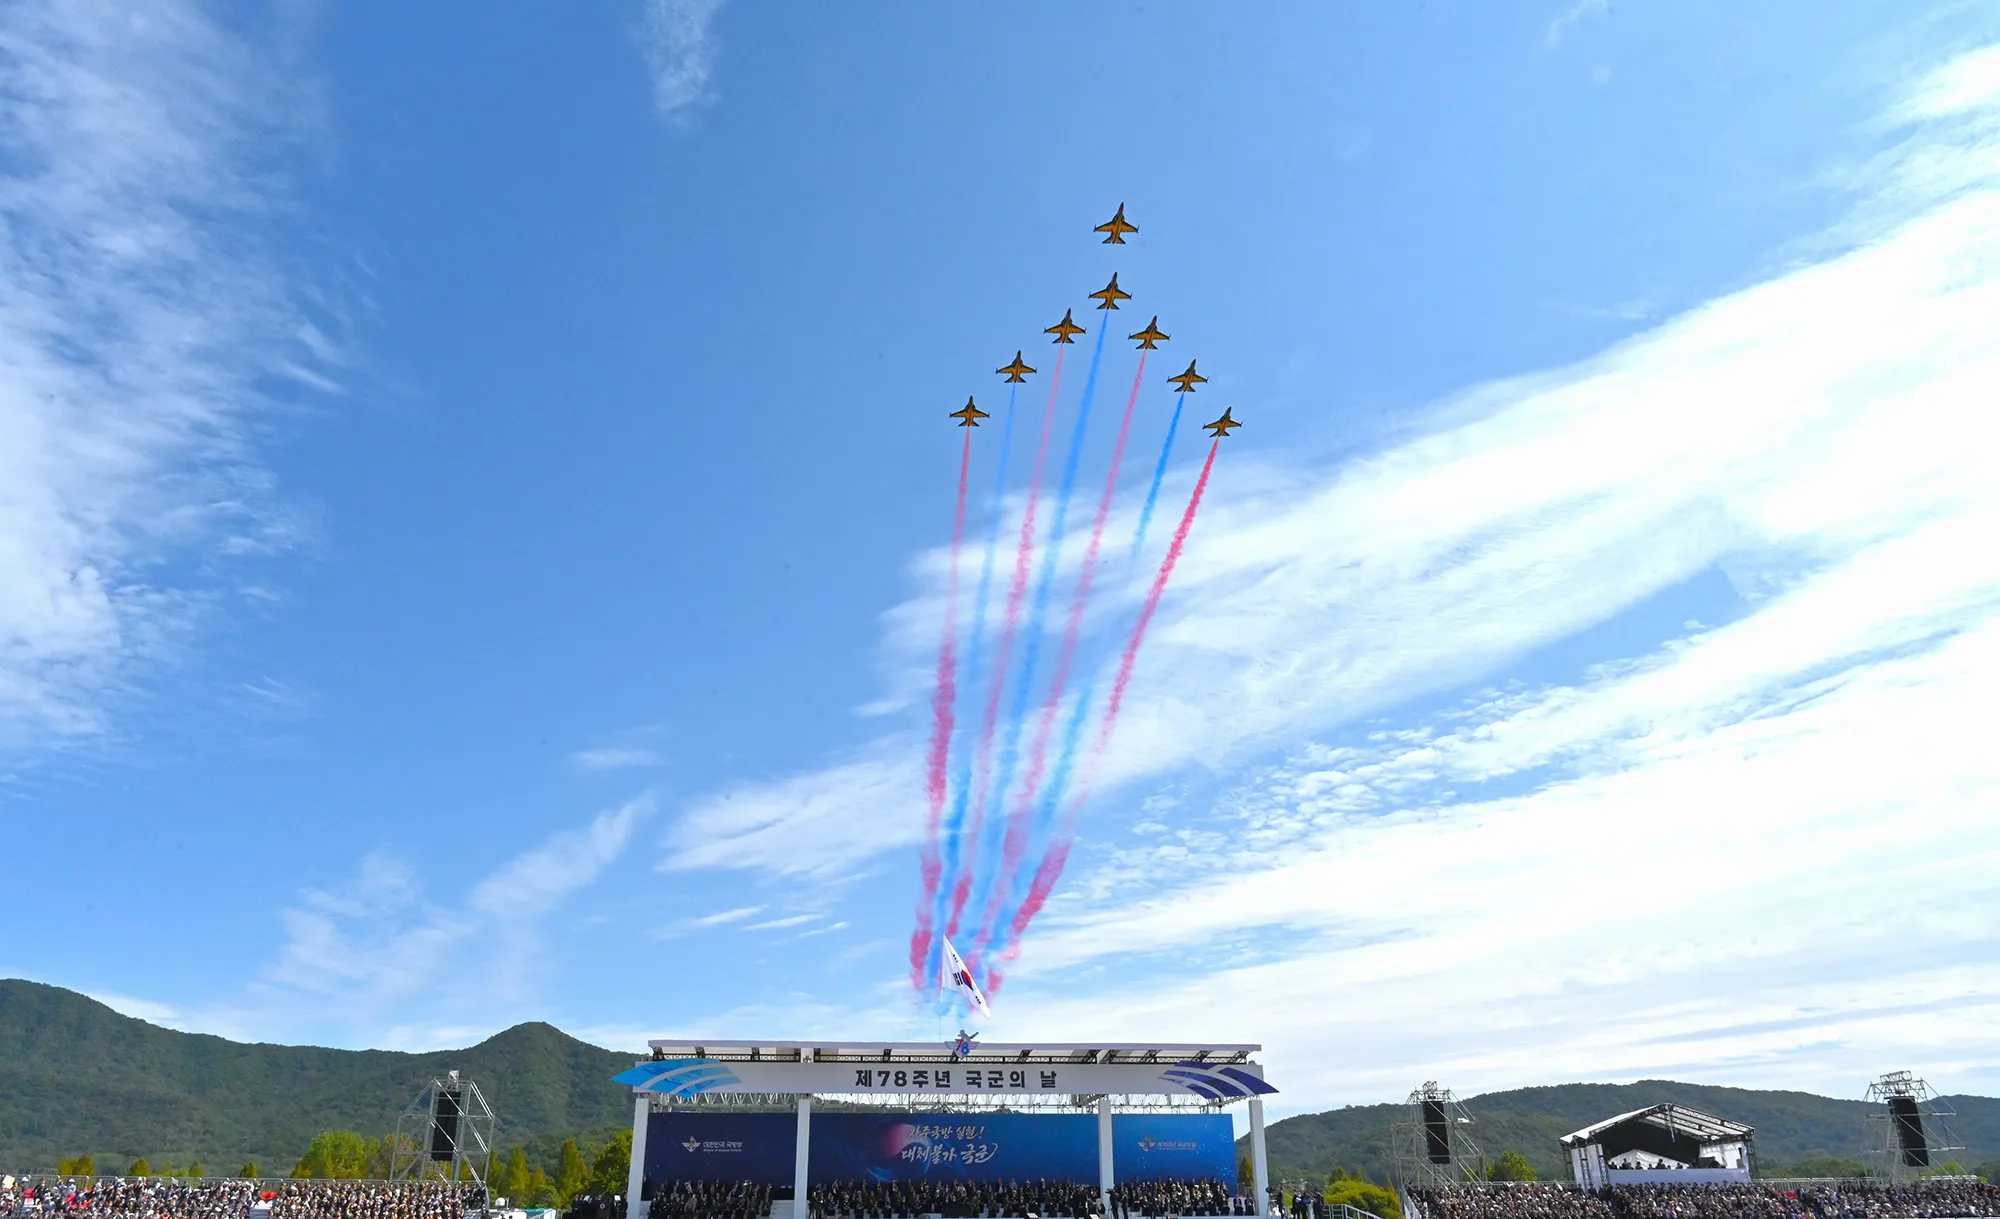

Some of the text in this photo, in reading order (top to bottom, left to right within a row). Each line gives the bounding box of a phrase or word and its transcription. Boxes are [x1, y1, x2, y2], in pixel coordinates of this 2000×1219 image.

[955, 1038, 969, 1054] 78
[855, 1069, 1057, 1089] 제78주년 국군의 날
[909, 1125, 953, 1140] 자주국방
[901, 1142, 999, 1165] 대체불가 국군
